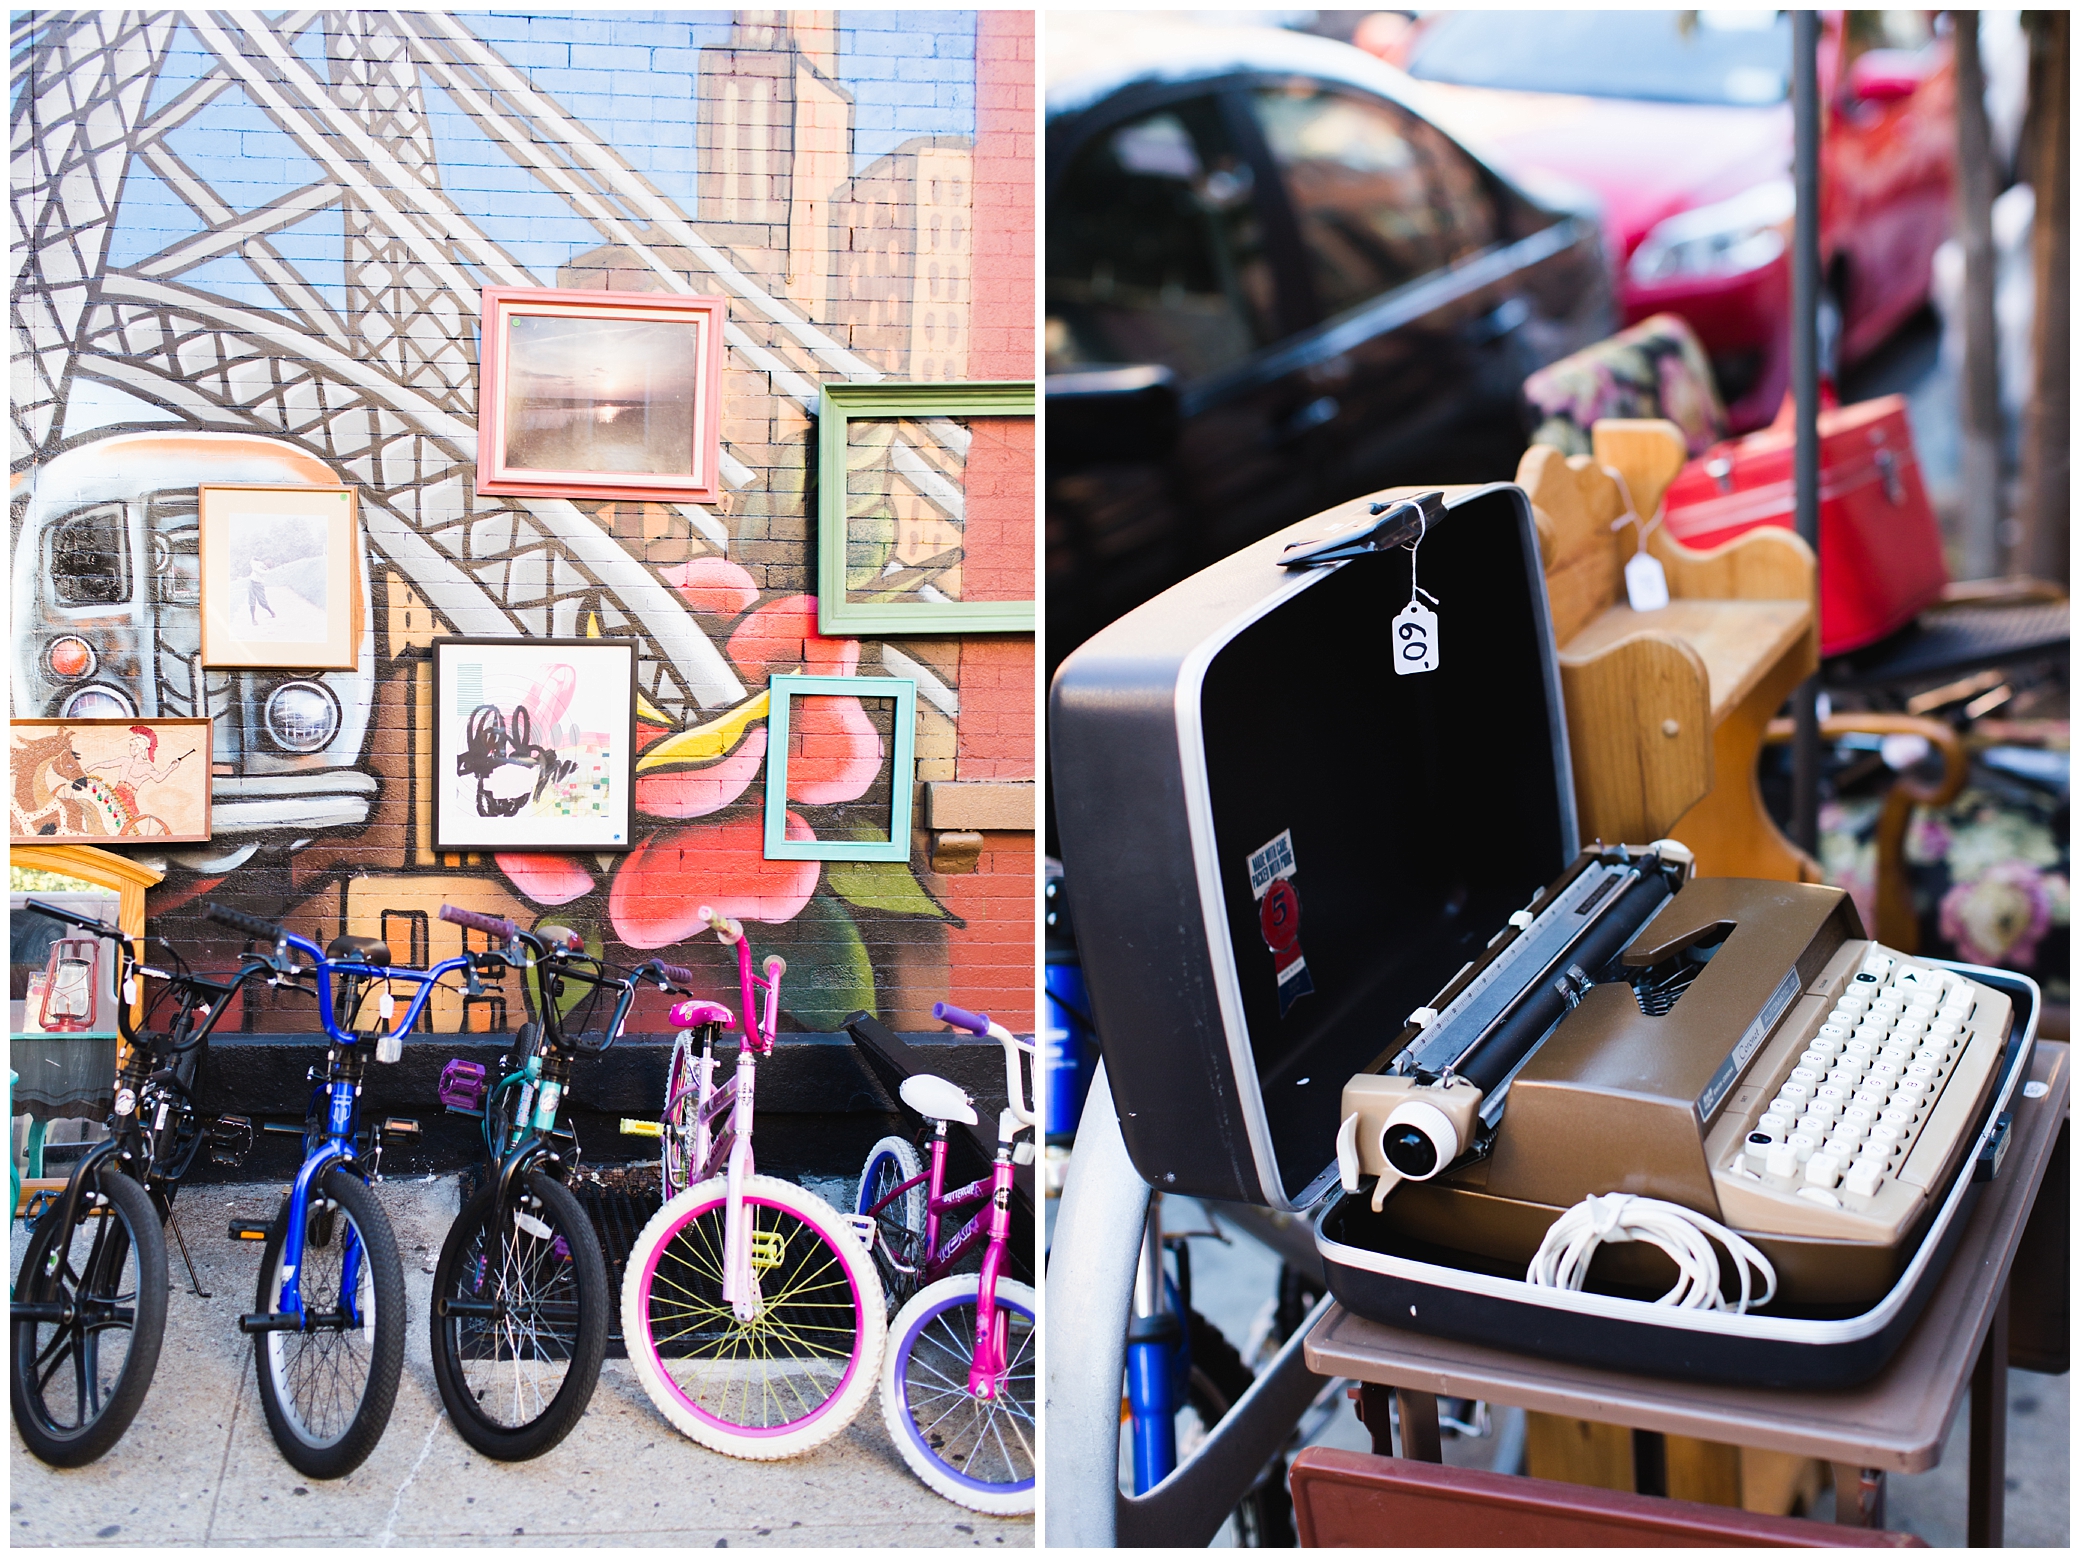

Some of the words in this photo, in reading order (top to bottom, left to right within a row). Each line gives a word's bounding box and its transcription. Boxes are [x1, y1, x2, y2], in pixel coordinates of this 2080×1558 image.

[1251, 851, 1266, 873] MADE
[1264, 844, 1278, 863] WITH
[1275, 836, 1288, 856] CARE
[1251, 866, 1270, 890] PACKED
[1268, 858, 1281, 878] WITH
[1279, 849, 1293, 870] PRIDE
[1272, 890, 1287, 926] 5
[1738, 1027, 1760, 1060] Coronet
[1763, 985, 1790, 1023] AUTOMATIC
[938, 1219, 973, 1263] NEXT
